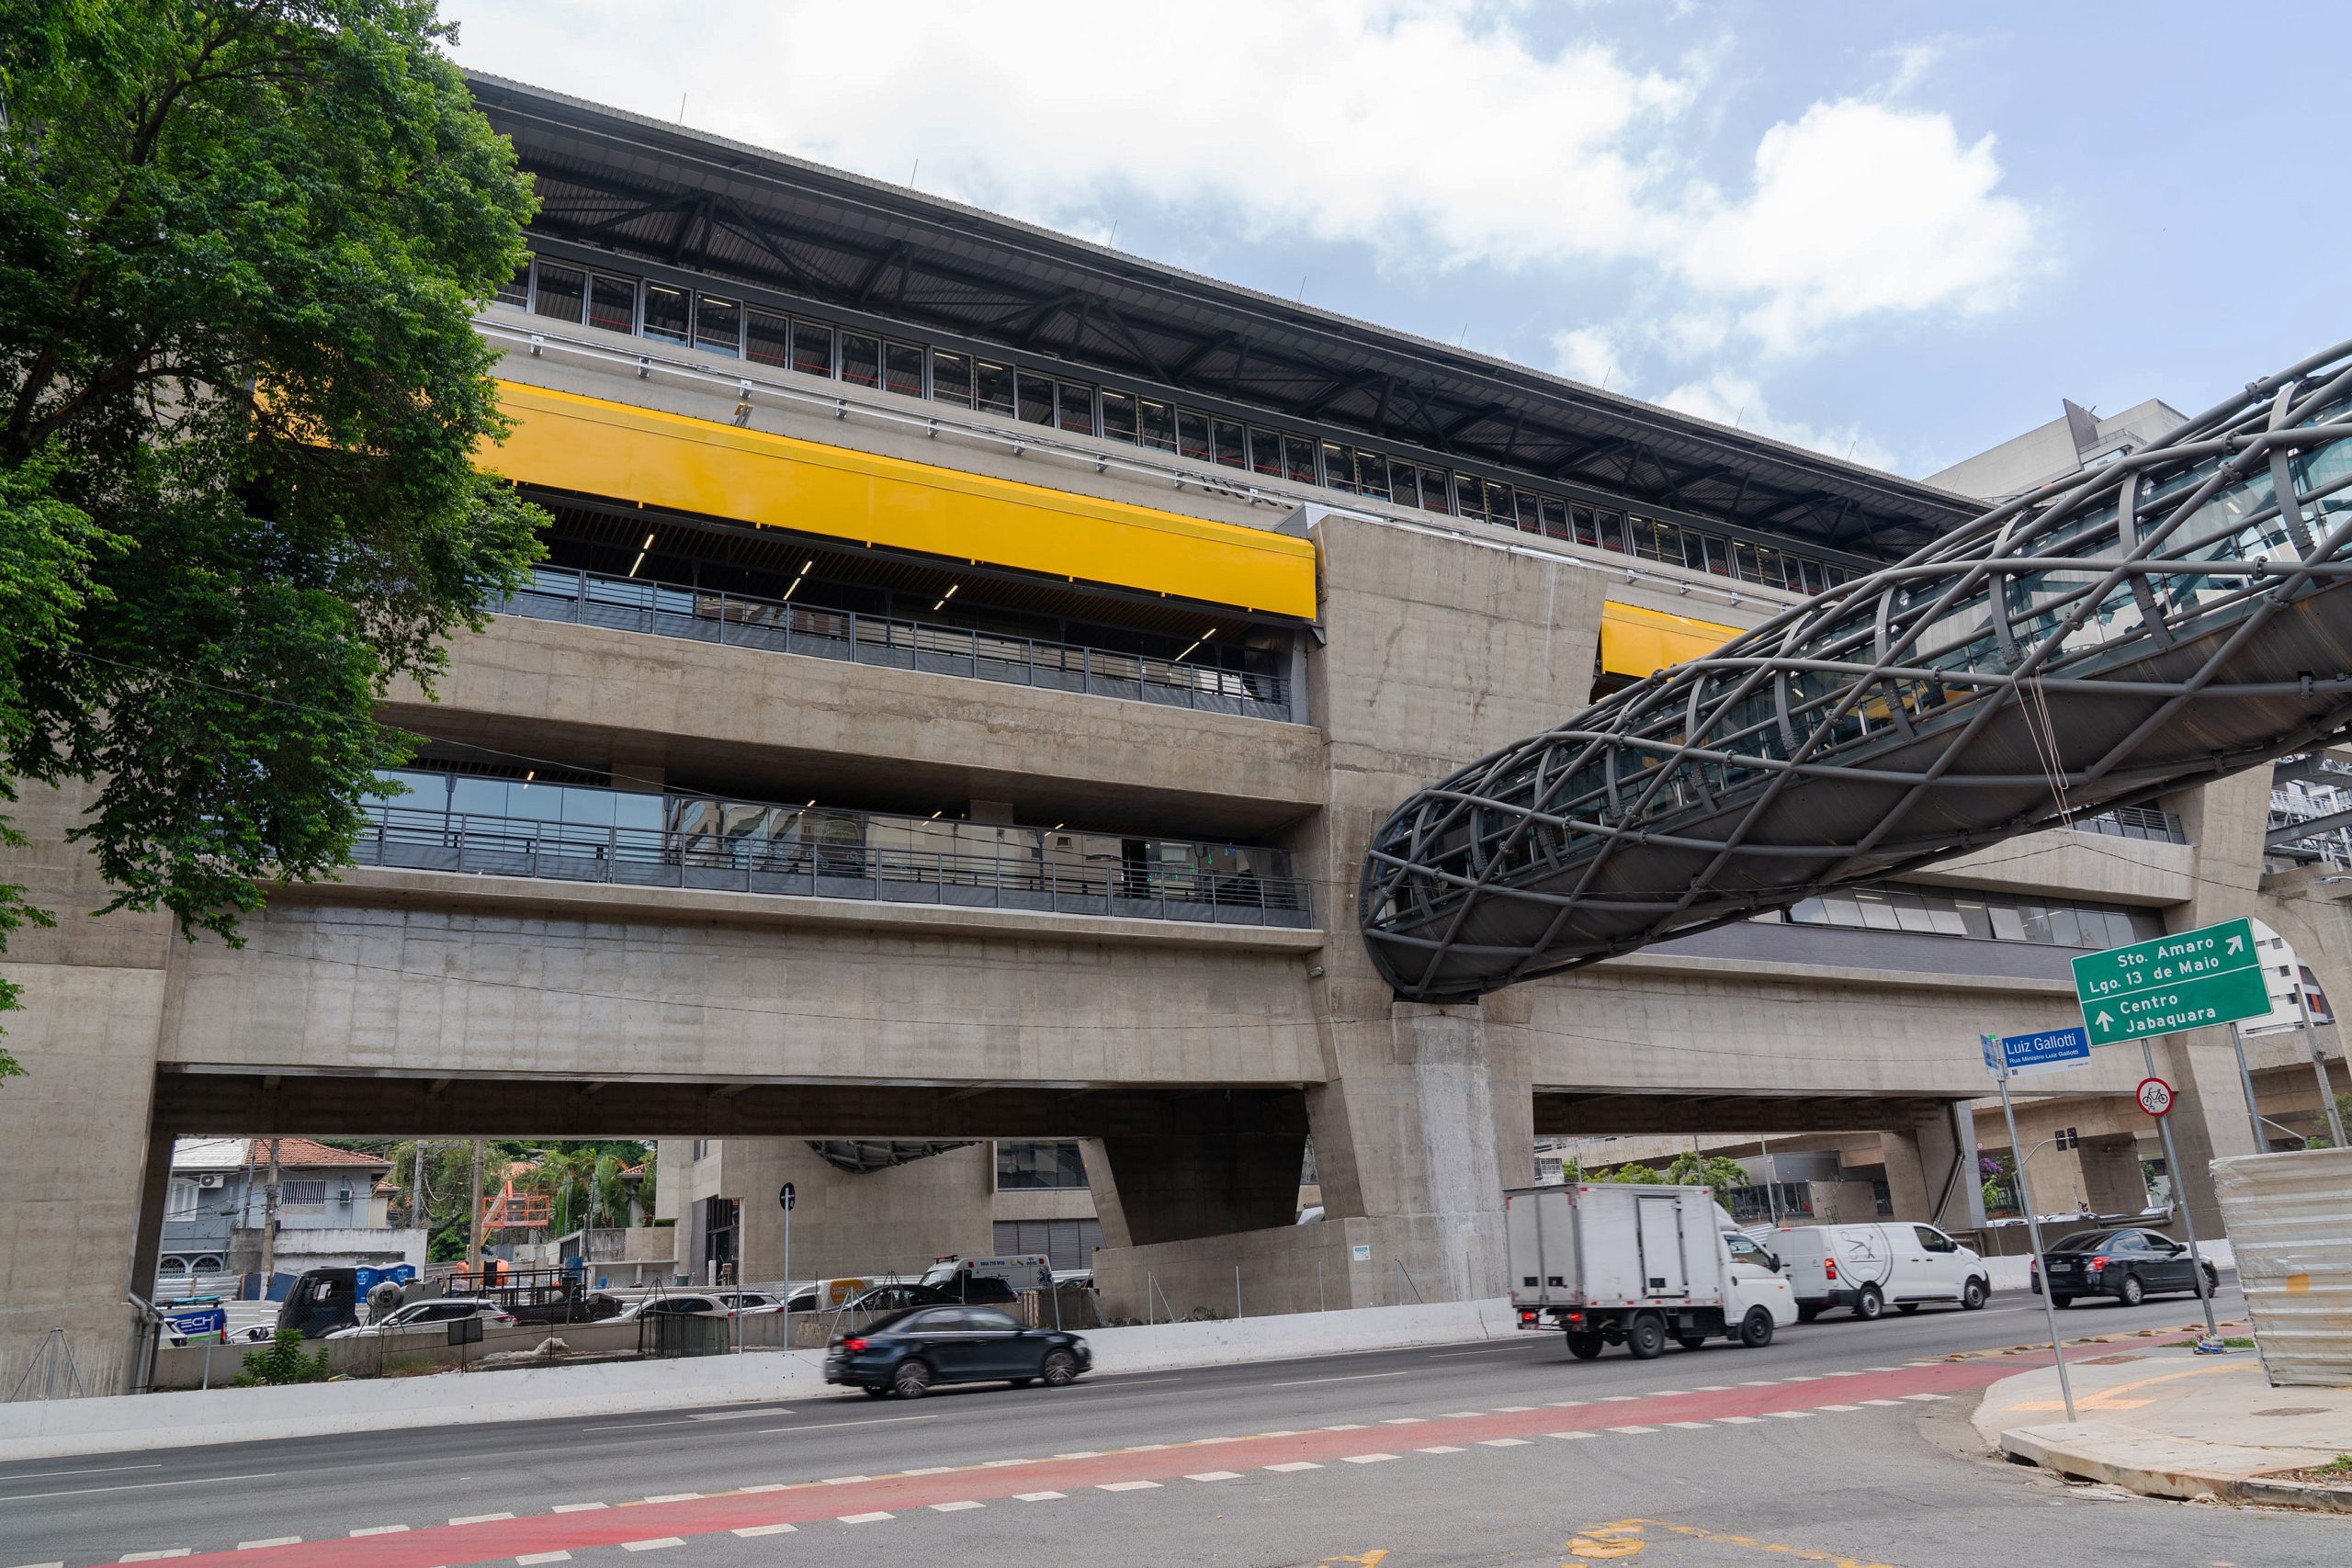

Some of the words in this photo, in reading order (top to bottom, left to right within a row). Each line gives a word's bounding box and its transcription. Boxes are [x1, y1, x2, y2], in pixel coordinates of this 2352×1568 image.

[2117, 954, 2148, 968] Sto.
[2157, 938, 2214, 960] Amaro
[2088, 980, 2121, 995] Lgo.
[2126, 971, 2143, 986] 13
[2154, 966, 2173, 980] de
[2178, 956, 2220, 975] Maio
[2120, 994, 2178, 1014] Centro
[2125, 1007, 2217, 1033] Jabaquara
[2006, 1040, 2031, 1055] Luiz
[2033, 1032, 2076, 1051] Gallotti
[2021, 1054, 2045, 1062] Ministro
[2058, 1048, 2079, 1057] Gallotti
